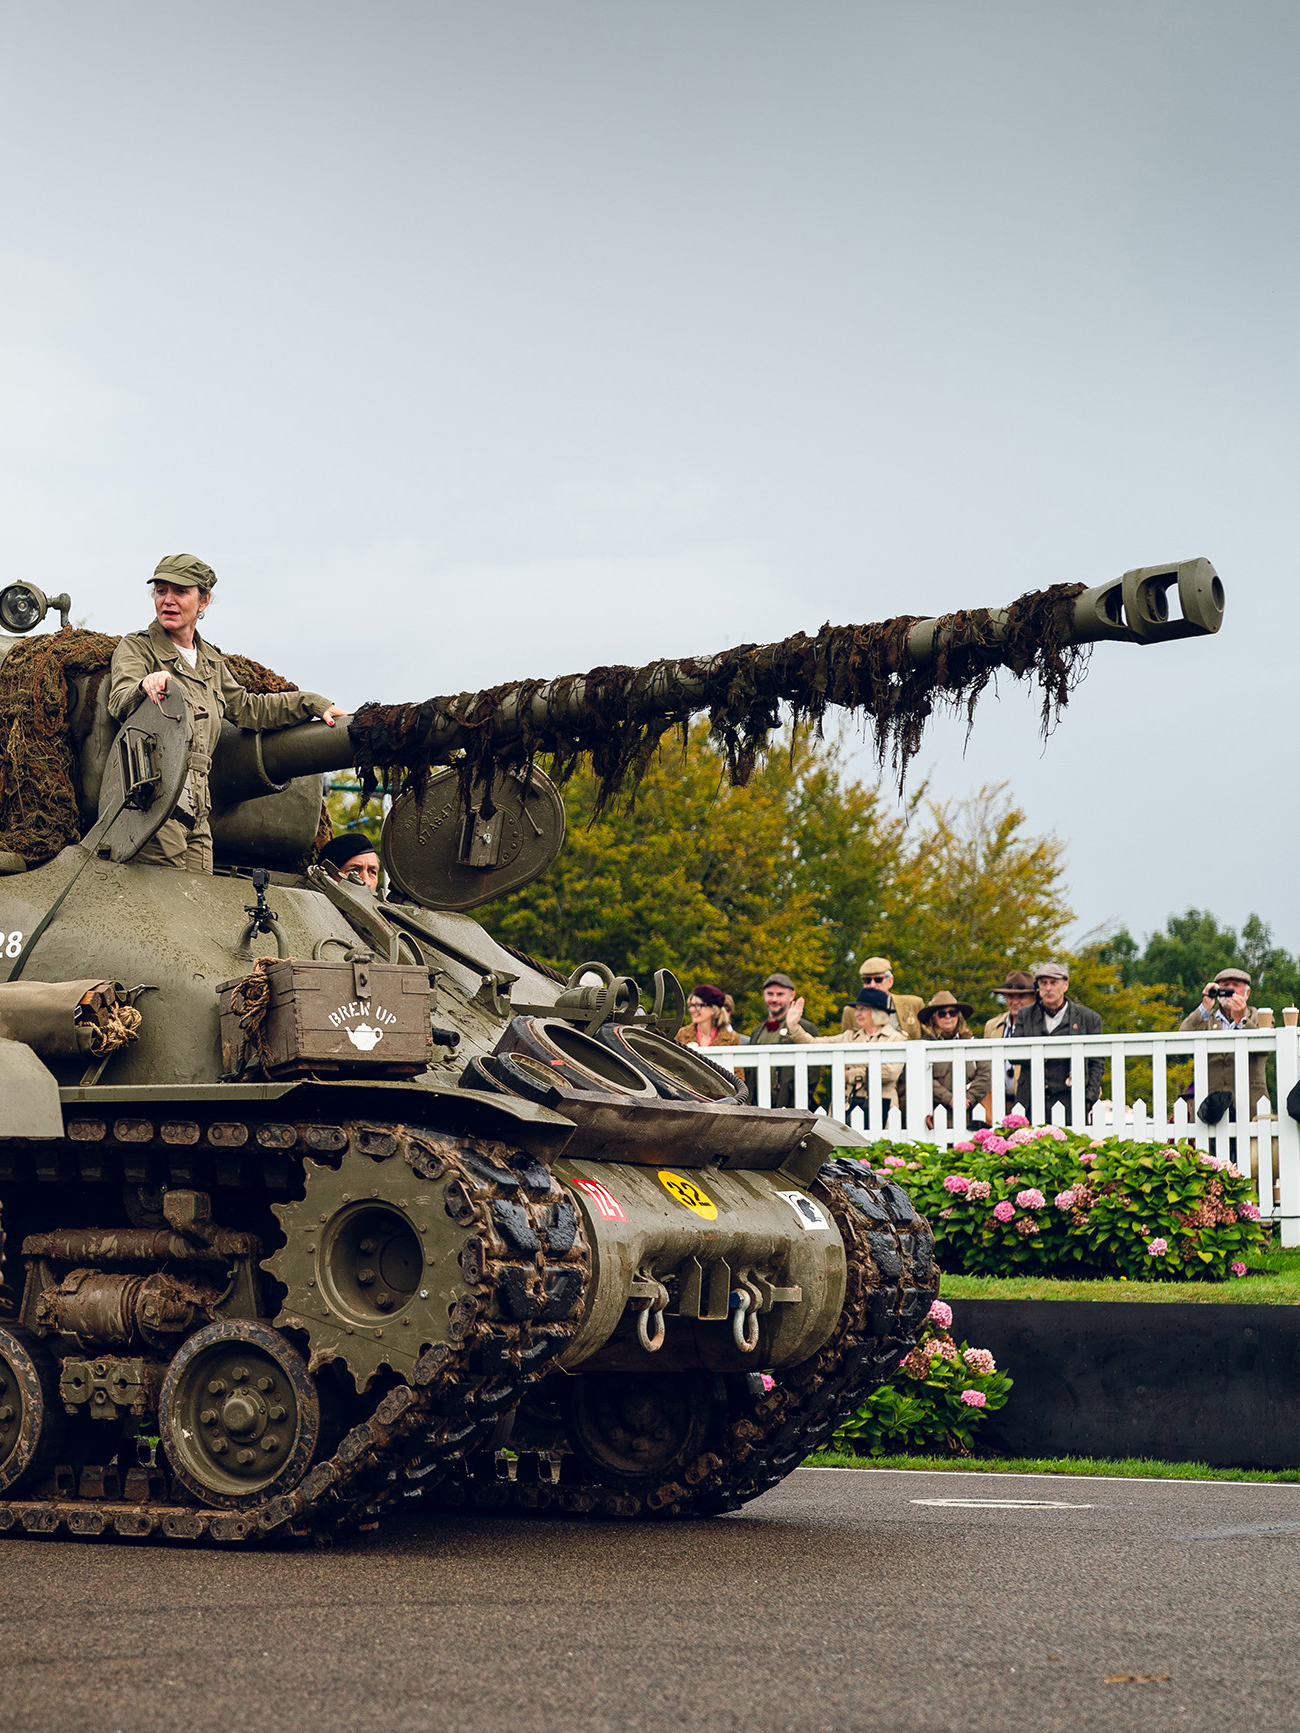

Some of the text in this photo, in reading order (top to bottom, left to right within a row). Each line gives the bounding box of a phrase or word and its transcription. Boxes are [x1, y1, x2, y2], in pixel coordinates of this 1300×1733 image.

[328, 1001, 397, 1027] BREW UP
[578, 1182, 624, 1218] 124
[666, 1181, 712, 1207] 32
